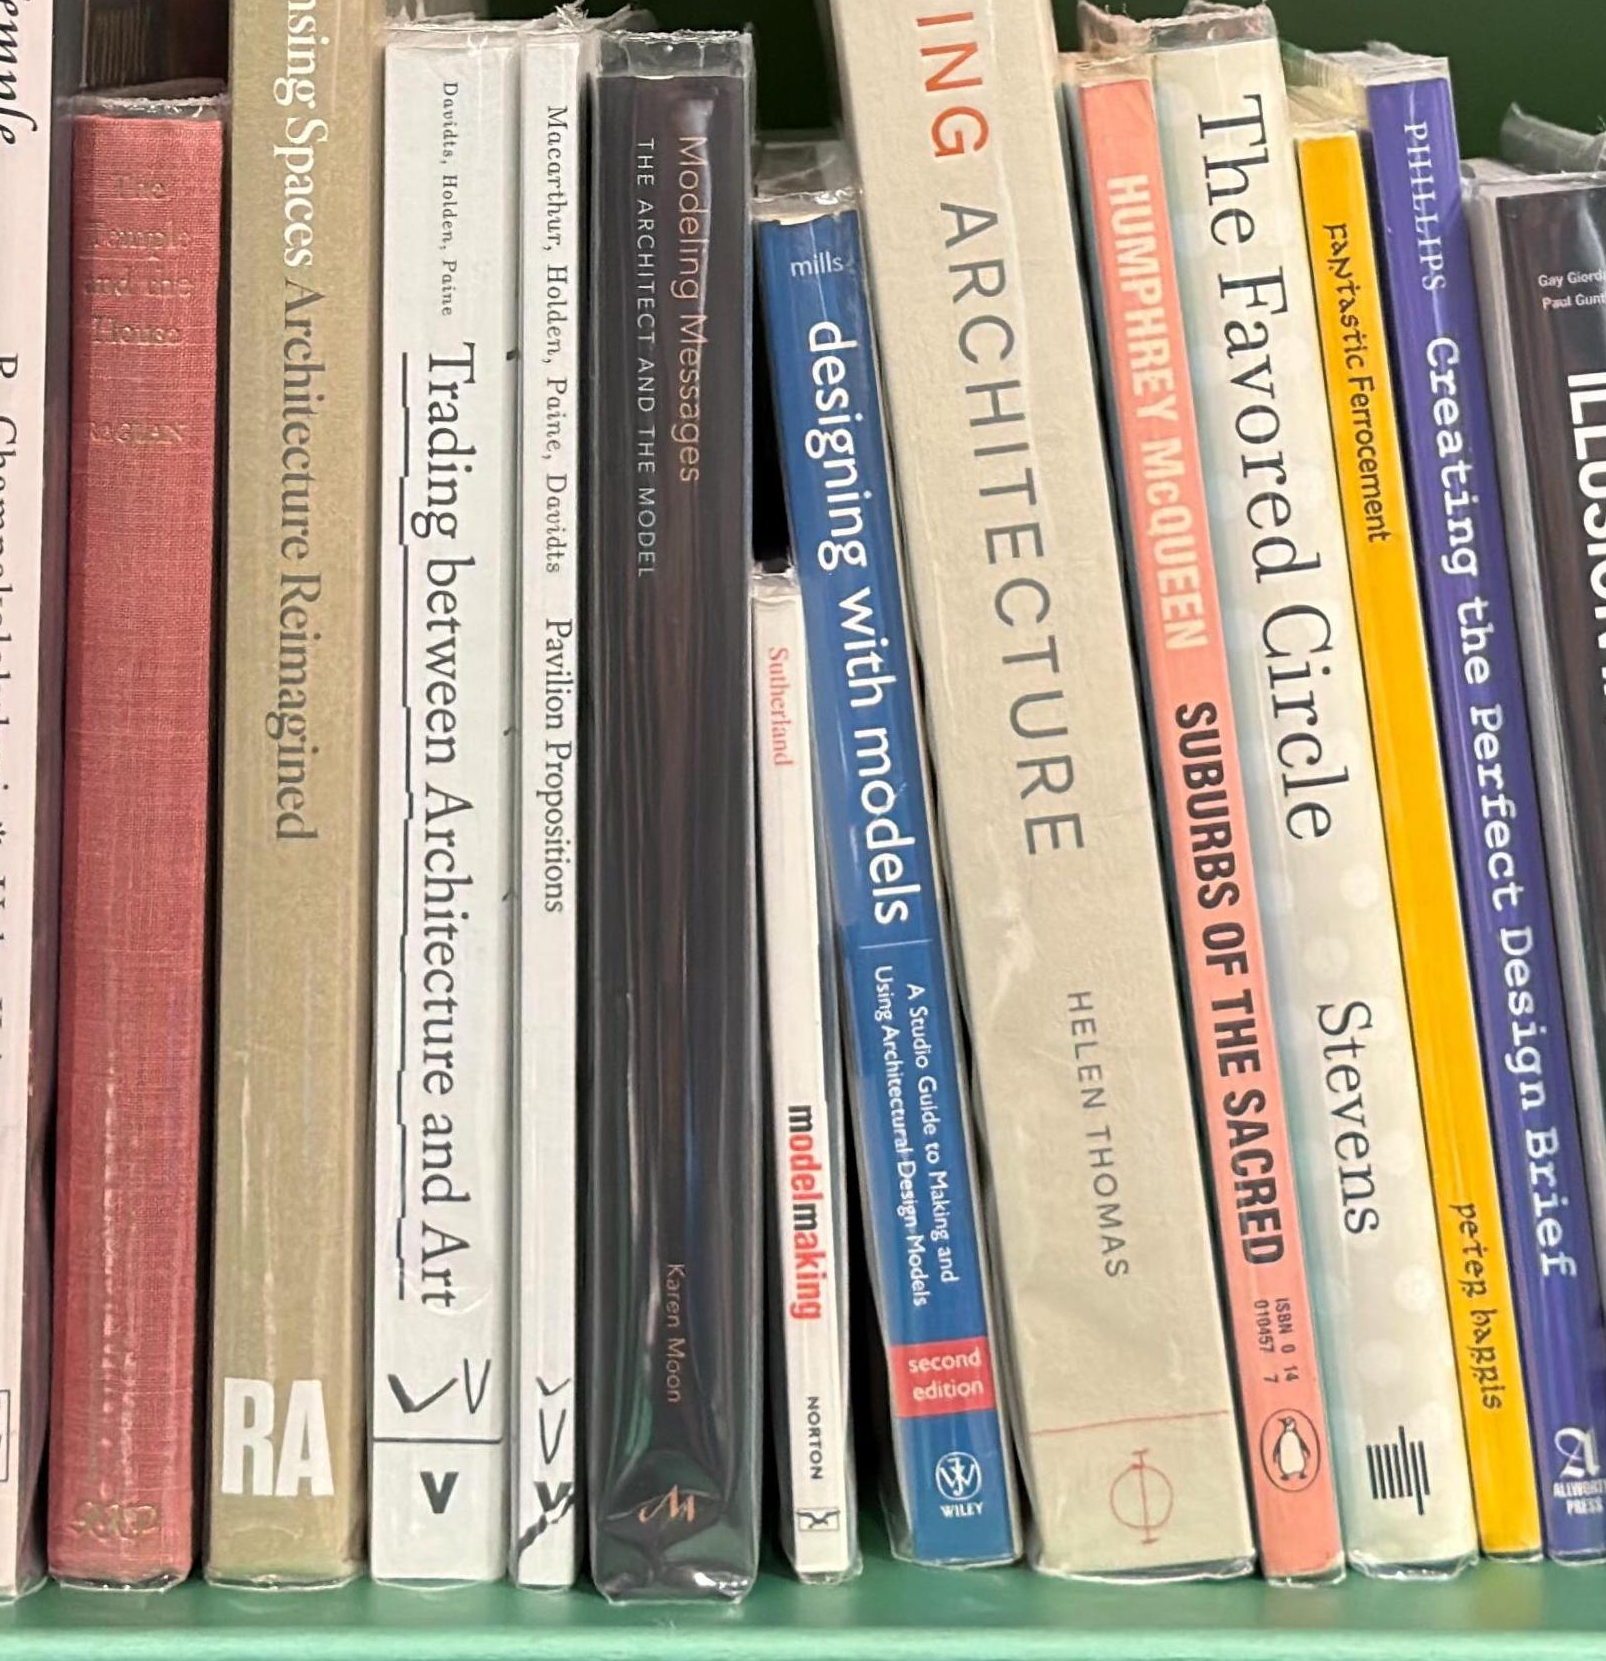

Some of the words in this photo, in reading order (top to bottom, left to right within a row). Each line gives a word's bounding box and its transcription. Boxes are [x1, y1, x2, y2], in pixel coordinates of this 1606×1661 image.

[442, 81, 459, 165] Davidts,
[542, 104, 569, 253] Macarthur,
[638, 138, 656, 187] THE
[1196, 92, 1269, 247] The
[273, 118, 328, 266] Spaces
[441, 174, 457, 250] Holden,
[672, 135, 709, 302] Modeling
[1404, 120, 1447, 292] PHILLIPS
[441, 260, 456, 317] Paine
[542, 263, 569, 365] Holden,
[637, 198, 655, 347] ARCHITECT
[790, 251, 844, 278] mills
[1106, 172, 1178, 421] HUMPHREY
[1538, 274, 1564, 287] Gay
[1542, 295, 1571, 310] Paul
[280, 278, 329, 560] Architecture
[412, 341, 477, 539] Trading
[542, 378, 569, 462] Paine,
[637, 358, 655, 413] AND
[670, 313, 707, 483] Messages
[1218, 264, 1322, 585] Favored
[637, 424, 655, 477] THE
[805, 321, 873, 571] designing
[1348, 375, 1391, 543] Ferrocement
[1425, 336, 1480, 580] Creating
[544, 472, 569, 574] Davidts
[637, 485, 655, 578] MODEL
[940, 201, 1085, 856] ARCHITECTURE
[1137, 435, 1209, 651] McQUEEN
[426, 557, 477, 765] between
[543, 618, 573, 731] Pavilion
[839, 587, 896, 708] with
[1457, 597, 1494, 685] the
[266, 572, 323, 841] Reimagined
[768, 647, 794, 767] Sutherland
[1262, 603, 1349, 841] Circle
[541, 740, 572, 914] Propositions
[854, 729, 921, 925] models
[1174, 700, 1238, 910] SUBURBS
[1471, 703, 1518, 911] Perfect
[423, 789, 473, 1095] Architecture
[873, 966, 893, 1021] Using
[907, 983, 925, 1000] A
[1200, 923, 1248, 976] OF
[907, 1004, 928, 1068] Studio
[1067, 990, 1107, 1111] HELEN
[1210, 990, 1262, 1076] THE
[1499, 926, 1546, 1111] Design
[881, 1024, 911, 1155] Architectural
[916, 1074, 937, 1136] Guide
[1317, 1000, 1380, 1235] Stevens
[423, 1111, 471, 1208] and
[895, 1160, 919, 1230] Design
[926, 1141, 940, 1162] to
[928, 1171, 950, 1240] Making
[1085, 1124, 1129, 1279] THOMAS
[1221, 1089, 1286, 1266] SACRED
[1526, 1128, 1577, 1279] Brief
[421, 1220, 470, 1308] Art
[787, 1105, 827, 1320] modelmaking
[908, 1234, 928, 1306] Models
[938, 1246, 958, 1283] and
[666, 1263, 685, 1327] Karen
[1275, 1297, 1293, 1335] ISBN
[666, 1338, 685, 1403] Moon
[908, 1347, 981, 1374] second
[913, 1380, 984, 1402] edition
[222, 1377, 334, 1497] RA
[808, 1396, 824, 1480] NORTON
[940, 1502, 984, 1518] WILEY
